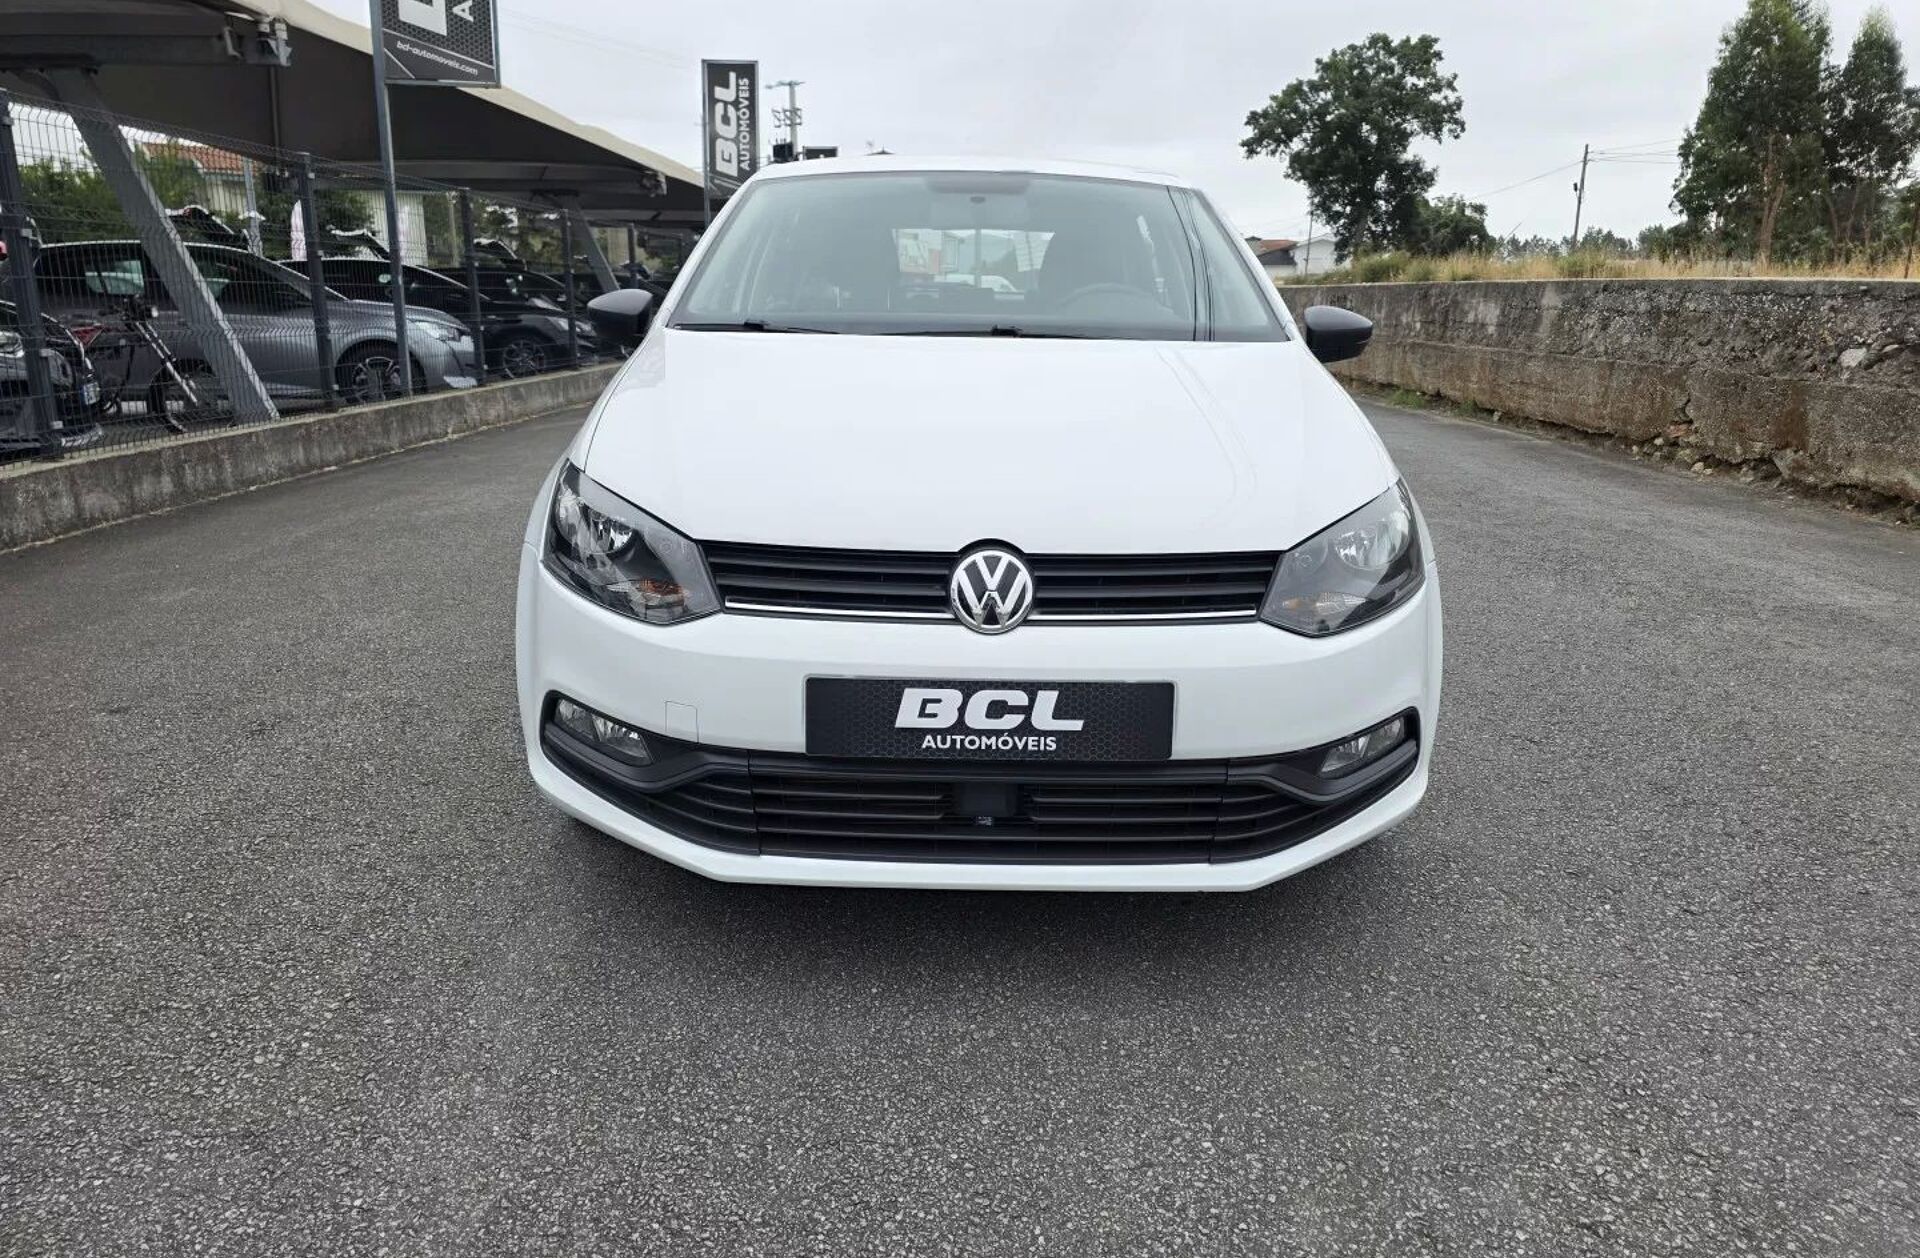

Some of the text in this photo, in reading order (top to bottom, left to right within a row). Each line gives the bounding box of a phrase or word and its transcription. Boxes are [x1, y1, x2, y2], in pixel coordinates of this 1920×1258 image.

[714, 71, 738, 177] BCL
[737, 77, 750, 171] AUTOMÓVEIS
[895, 688, 1085, 731] BCL
[921, 733, 1057, 751] AUTOMÓVEIS
